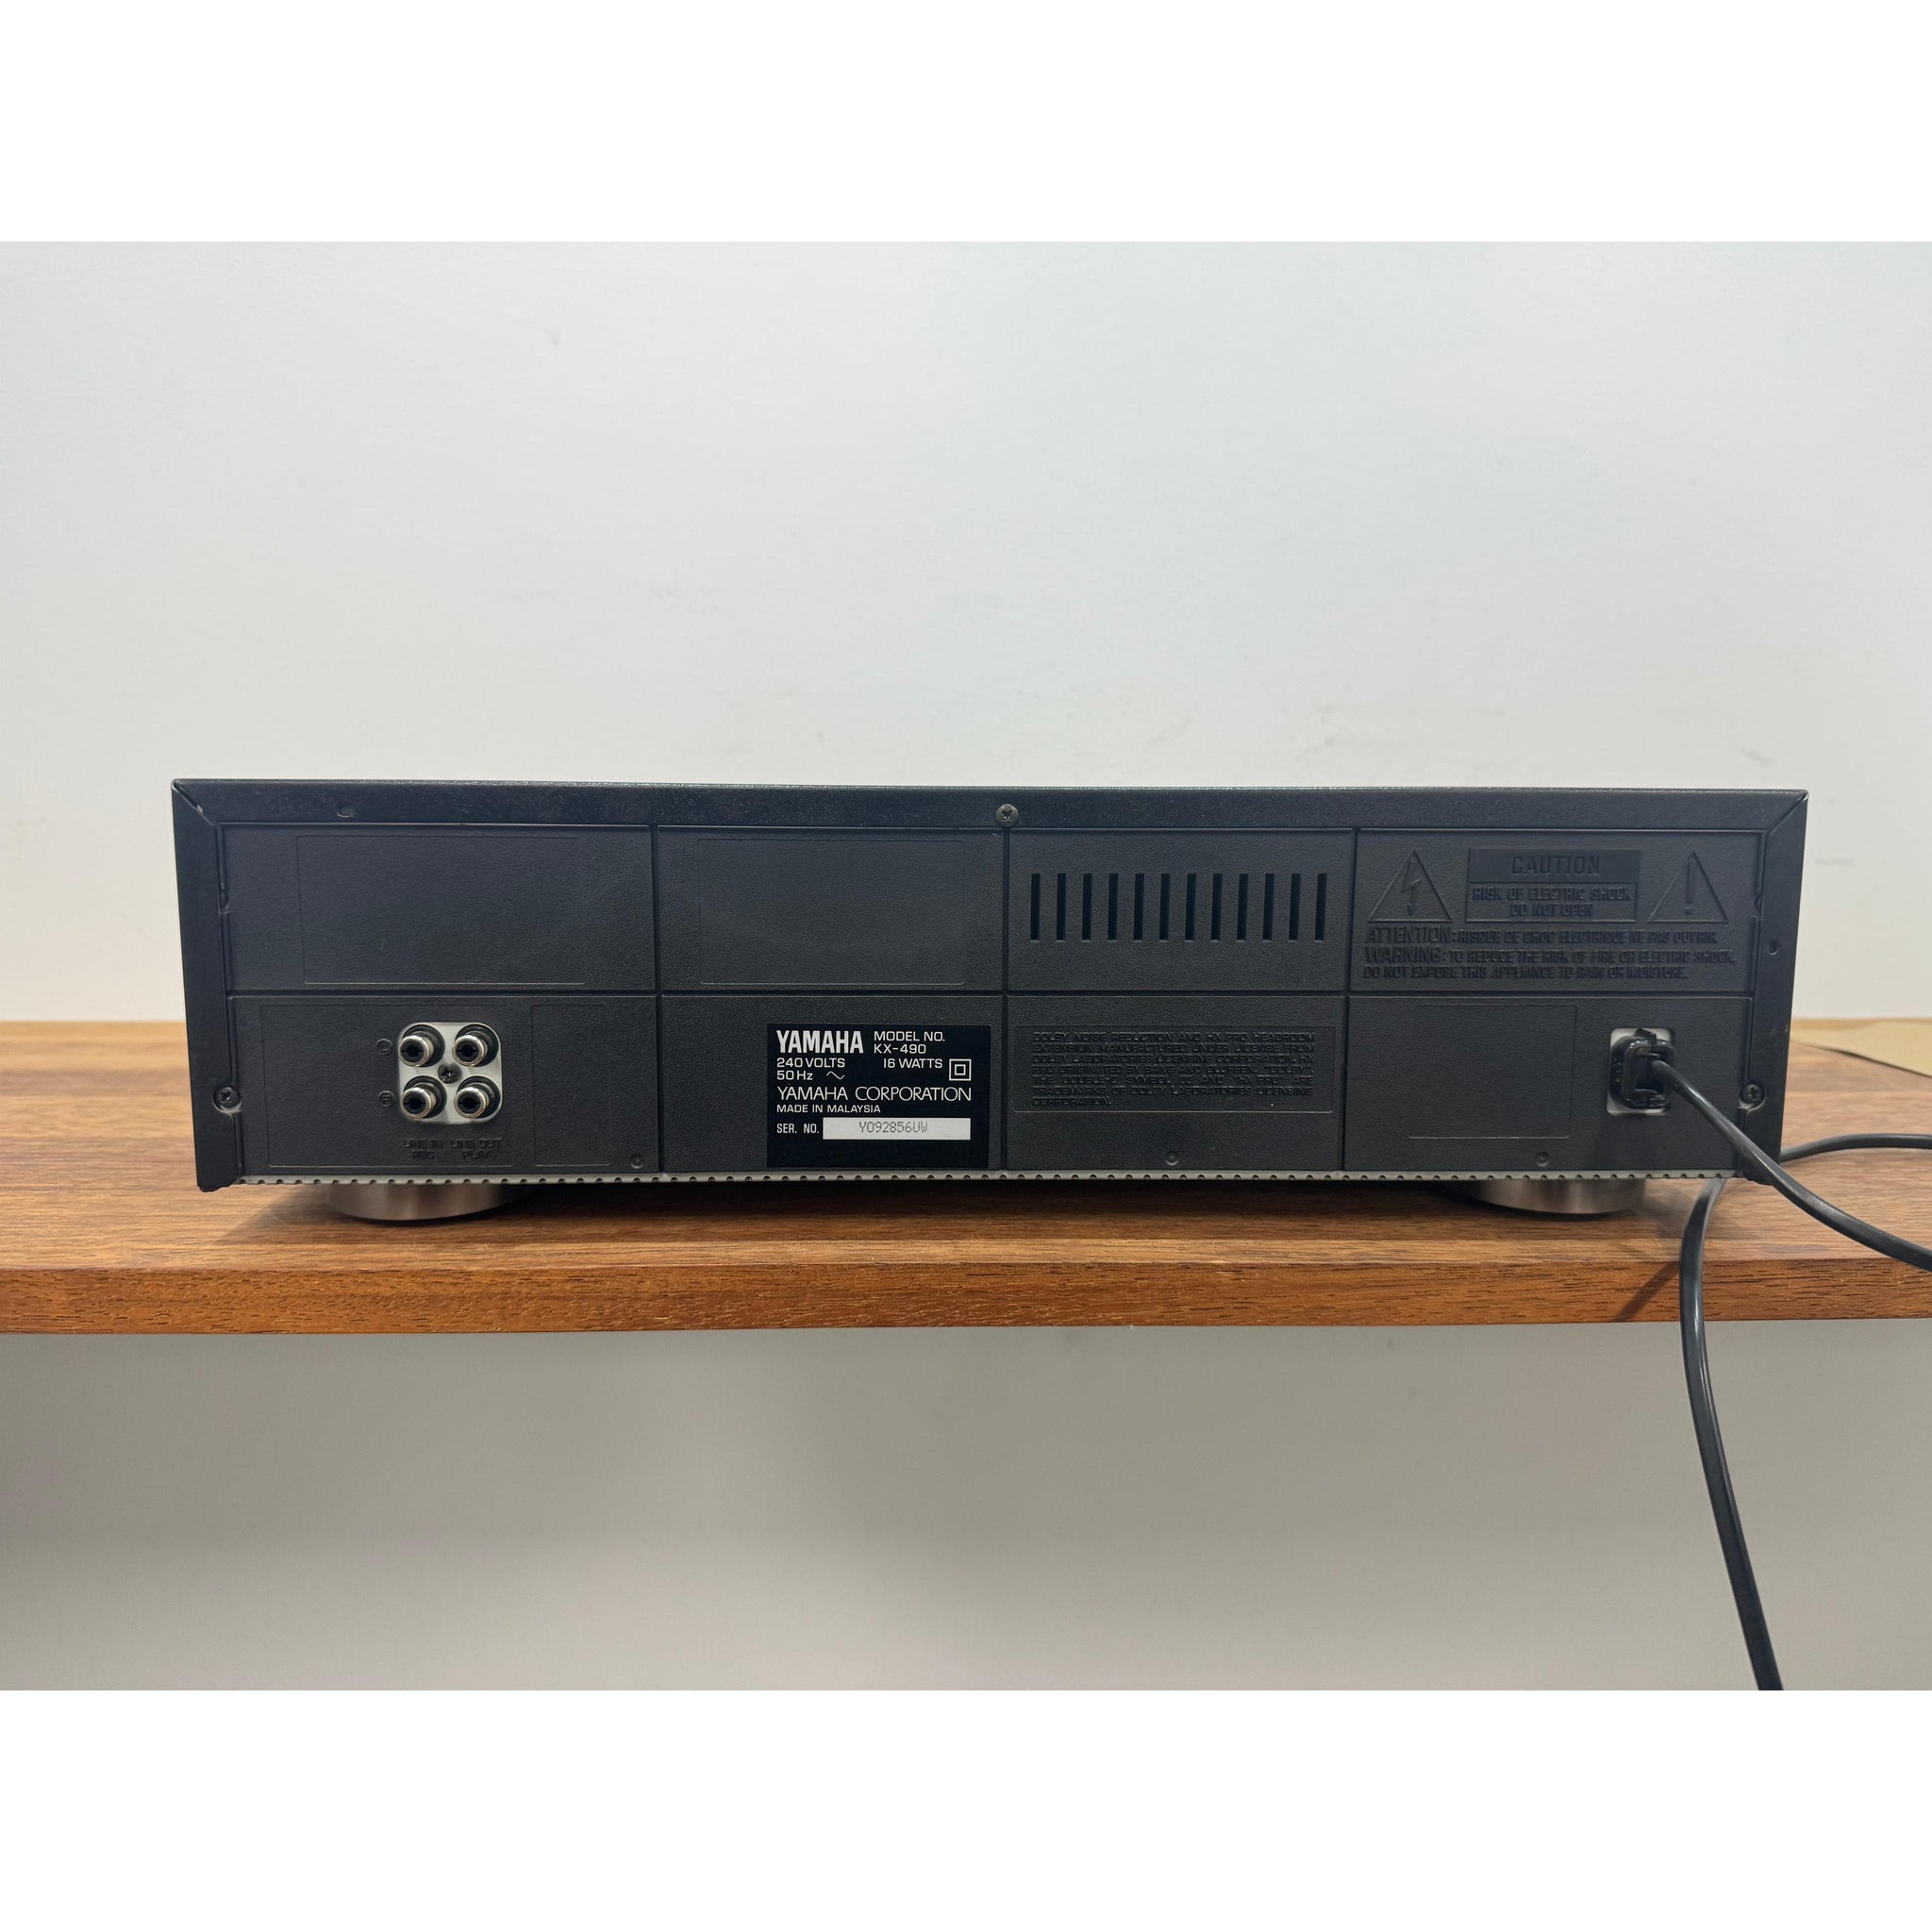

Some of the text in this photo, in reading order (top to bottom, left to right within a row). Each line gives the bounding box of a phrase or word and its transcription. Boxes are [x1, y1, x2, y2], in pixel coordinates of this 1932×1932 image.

[1511, 855, 1600, 875] CAUTION
[1472, 887, 1631, 901] RISK OF ELECTRIC SHOCK
[1509, 903, 1593, 917] DO NOT OPEN
[1448, 950, 1463, 963] TO
[1467, 950, 1512, 963] REDUCE
[1517, 950, 1540, 963] THE
[1543, 950, 1568, 963] RISK
[1572, 950, 1587, 963] OF
[1591, 950, 1615, 963] FIRE
[1363, 965, 1380, 979] DO
[1384, 965, 1407, 979] NOT
[1411, 965, 1457, 979] EXPOSE
[1461, 965, 1487, 979] THIS
[1491, 965, 1556, 979] APPLIANCE
[1558, 965, 1573, 979] TO
[1576, 965, 1606, 979] RAIN
[1607, 965, 1624, 979] OR
[776, 1030, 864, 1054] YAMAHA
[874, 1031, 945, 1042] MODEL NO.
[874, 1043, 926, 1055] KX-490
[777, 1058, 845, 1068] 240 VOLTS
[884, 1058, 943, 1069] 16 WATTS
[777, 1071, 813, 1081] 50 Hz
[777, 1086, 972, 1102] YAMAHA CORPORATION
[776, 1105, 881, 1114] MADE IN MALAYSIA
[776, 1124, 819, 1134] SER. NO.
